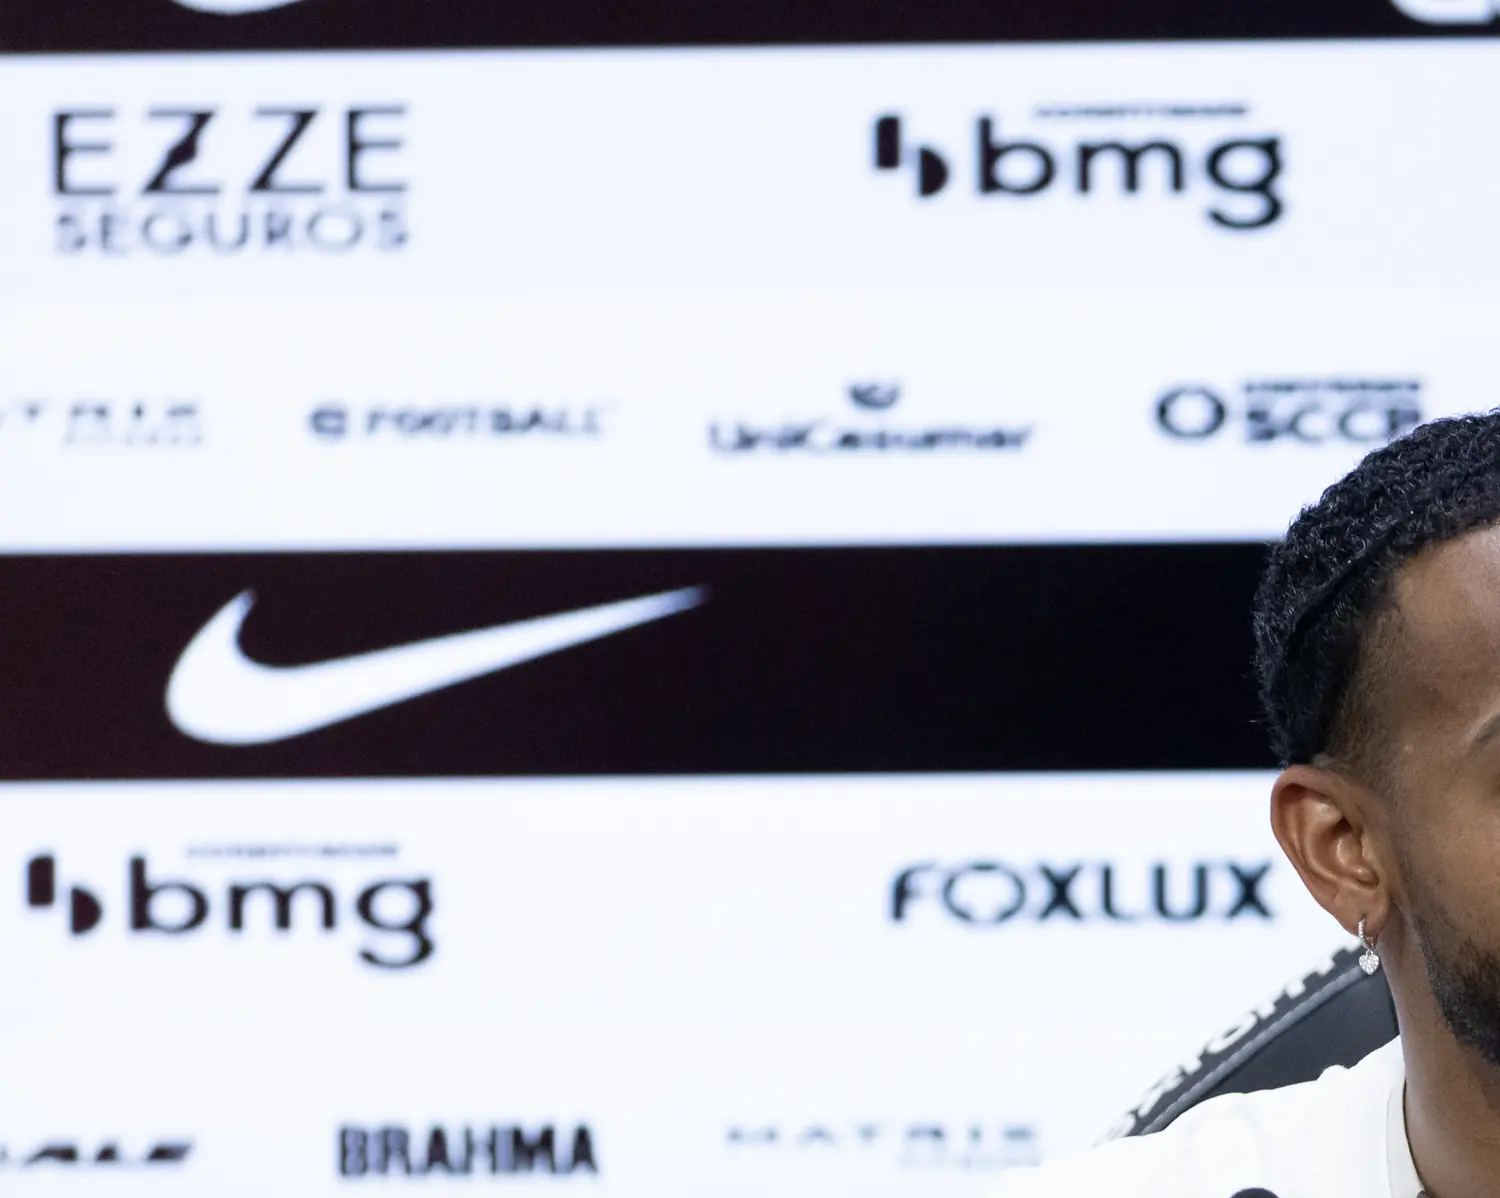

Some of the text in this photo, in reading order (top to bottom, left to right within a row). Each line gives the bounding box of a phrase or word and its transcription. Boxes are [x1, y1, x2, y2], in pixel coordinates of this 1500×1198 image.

[52, 105, 408, 197] EZZE
[976, 113, 1285, 231] bmg
[55, 205, 411, 255] SEGUROS
[128, 853, 436, 970] bmg
[890, 860, 1275, 924] FOXLUX
[336, 1122, 599, 1178] BRAHMA
